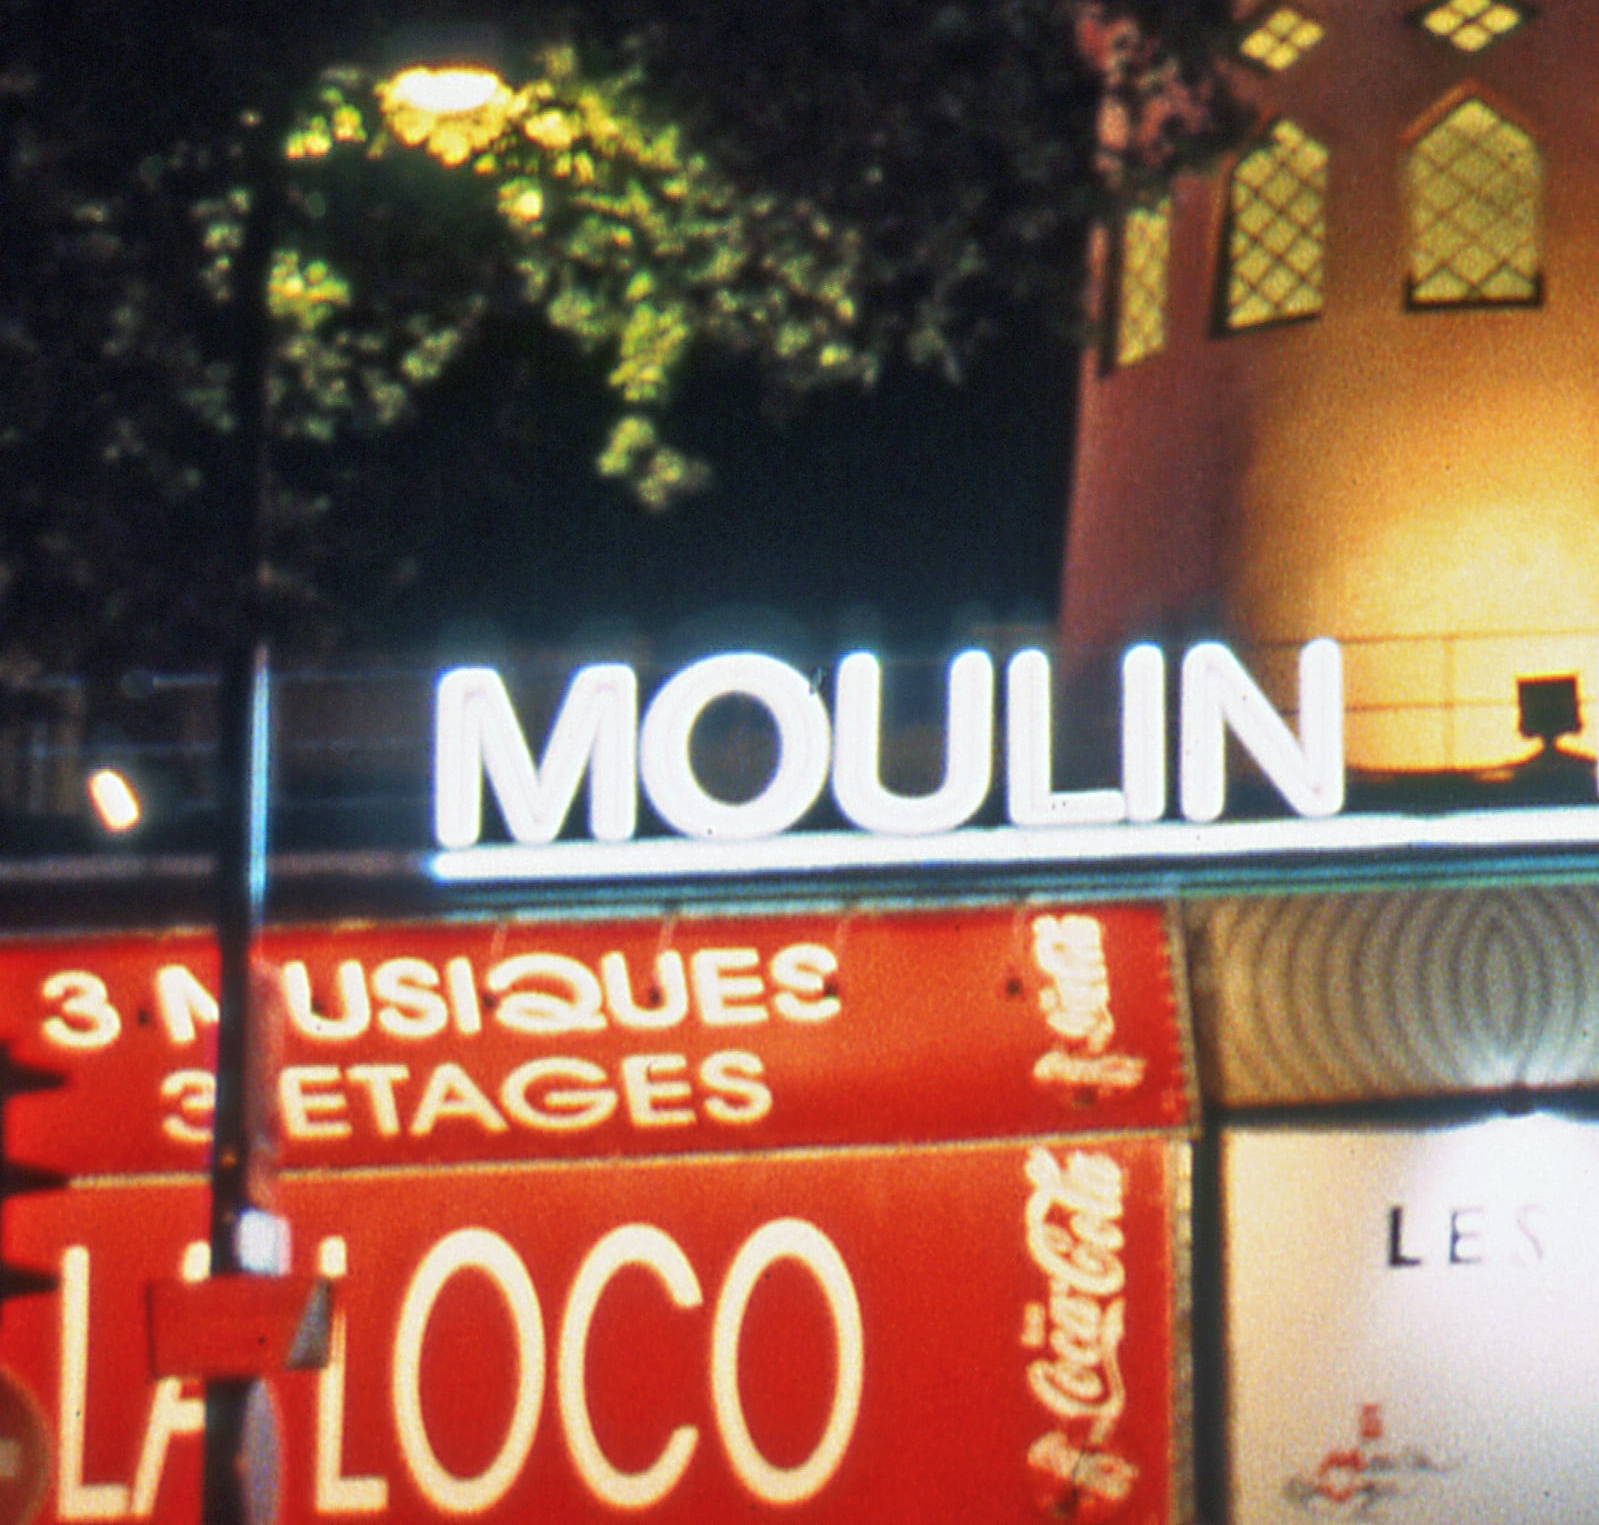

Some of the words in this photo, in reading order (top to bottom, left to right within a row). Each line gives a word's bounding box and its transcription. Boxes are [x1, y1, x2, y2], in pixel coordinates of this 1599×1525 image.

[434, 637, 1346, 848] MOULIN
[41, 969, 121, 1048] 3
[155, 942, 841, 1044] MUSIQUES
[160, 1068, 216, 1142] 3
[280, 1049, 773, 1138] ETAGES
[1386, 1203, 1544, 1268] LES
[315, 1217, 865, 1514] LOCO
